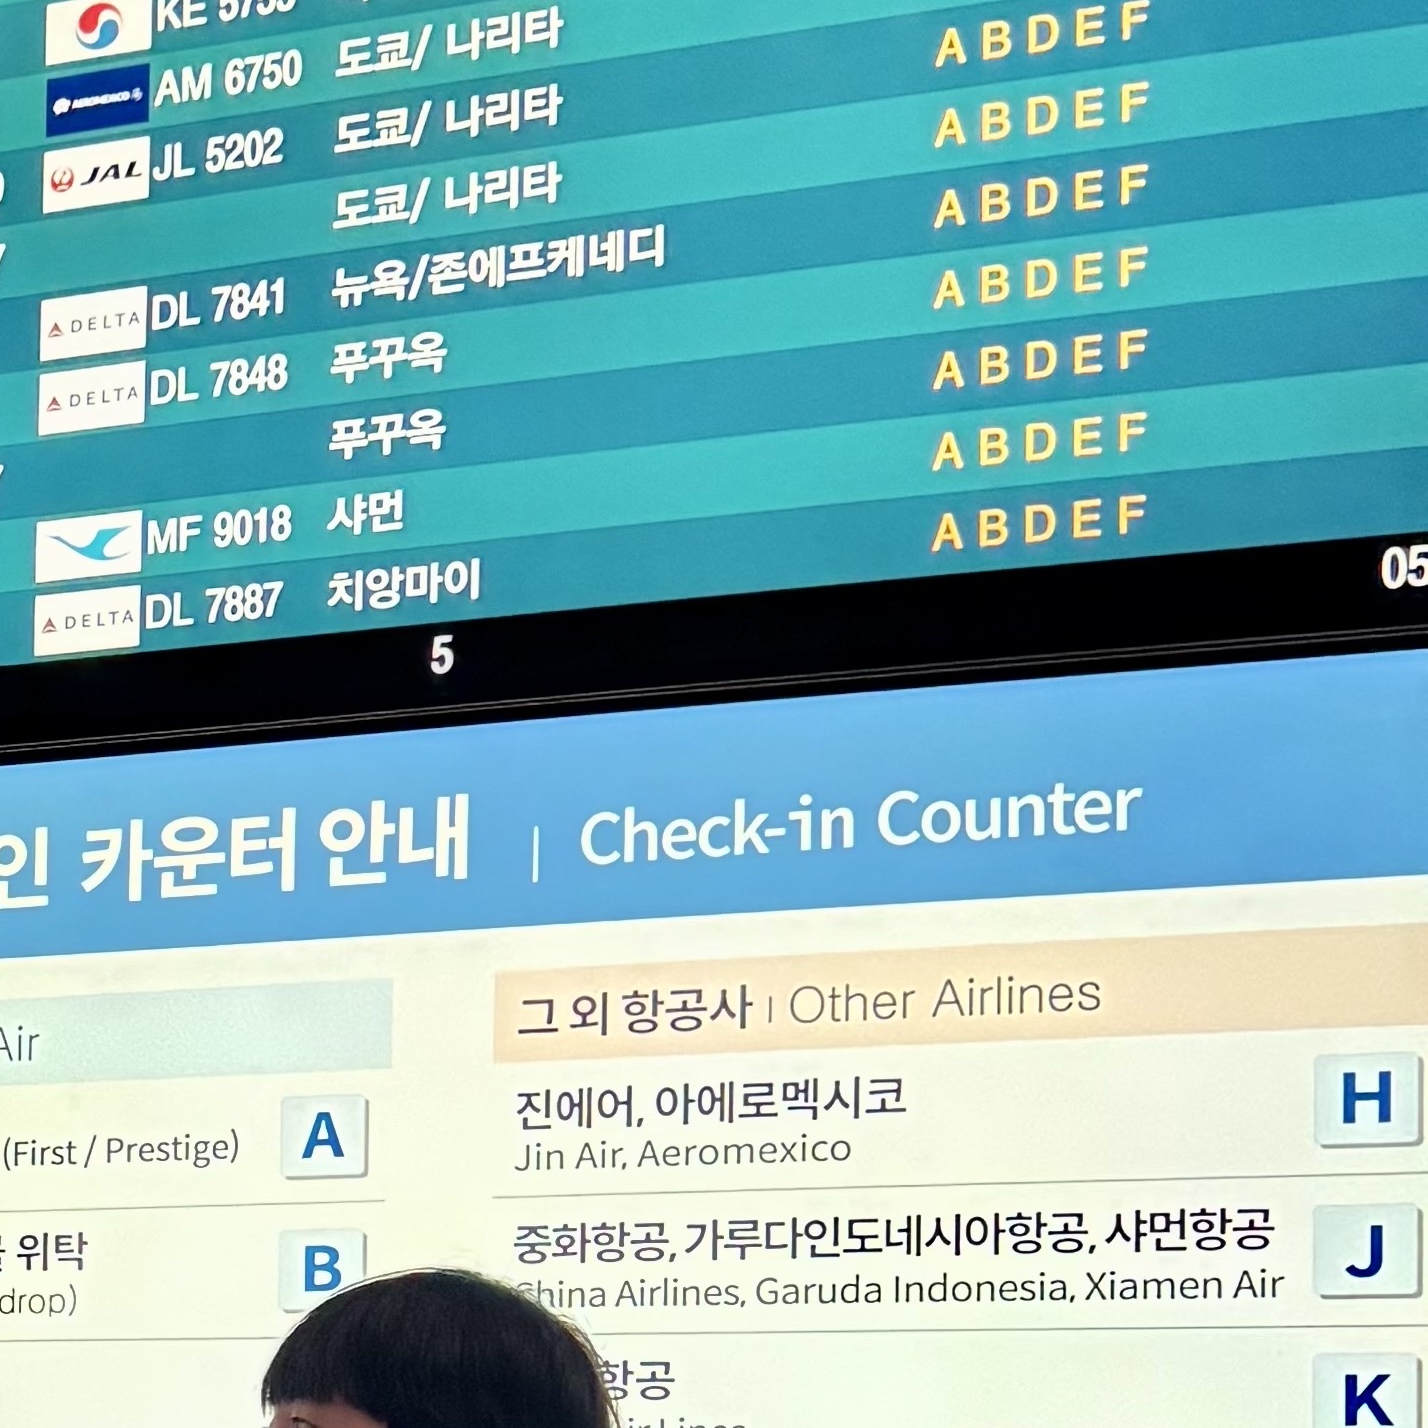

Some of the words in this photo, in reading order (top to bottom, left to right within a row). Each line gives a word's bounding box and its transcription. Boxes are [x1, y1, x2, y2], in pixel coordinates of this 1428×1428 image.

[154, 63, 212, 108] AM
[224, 49, 302, 95] 6750
[80, 161, 142, 186] JAL
[331, 224, 664, 308] 뉴욕/존에프케네디
[327, 558, 480, 611] 치앙마이
[81, 807, 296, 901] 카운터
[319, 794, 469, 886] 안내
[581, 794, 854, 865] Check-in
[878, 783, 1143, 845] Counter
[518, 999, 559, 1034] 그
[570, 992, 607, 1036] 외
[622, 984, 753, 1034] 항공사
[790, 984, 915, 1023] Other
[932, 976, 1100, 1017] Airlines
[517, 1085, 644, 1130] 진에어,
[656, 1076, 906, 1125] 아에로멕시코
[1343, 1071, 1391, 1124] H
[4, 1137, 77, 1171] (First
[107, 1128, 238, 1168] Prestige)
[302, 1112, 344, 1158] A
[515, 1143, 564, 1171] Jin
[575, 1140, 627, 1170] Air,
[637, 1133, 851, 1167] Aeromexico
[17, 1232, 88, 1271] 위탁
[514, 1222, 676, 1264] 중화항공,
[685, 1212, 1096, 1260] 가루다인도네시아항공,
[1105, 1208, 1275, 1253] 샤먼항공
[1346, 1225, 1383, 1278] J
[304, 1244, 343, 1293] B
[615, 1277, 745, 1308] Airlines,
[756, 1274, 881, 1305] Garuda
[895, 1272, 1075, 1303] Indonesia,
[1085, 1270, 1223, 1303] Xiamen
[1233, 1268, 1286, 1300] Air
[602, 1359, 676, 1400] 항공
[1345, 1374, 1394, 1426] K
